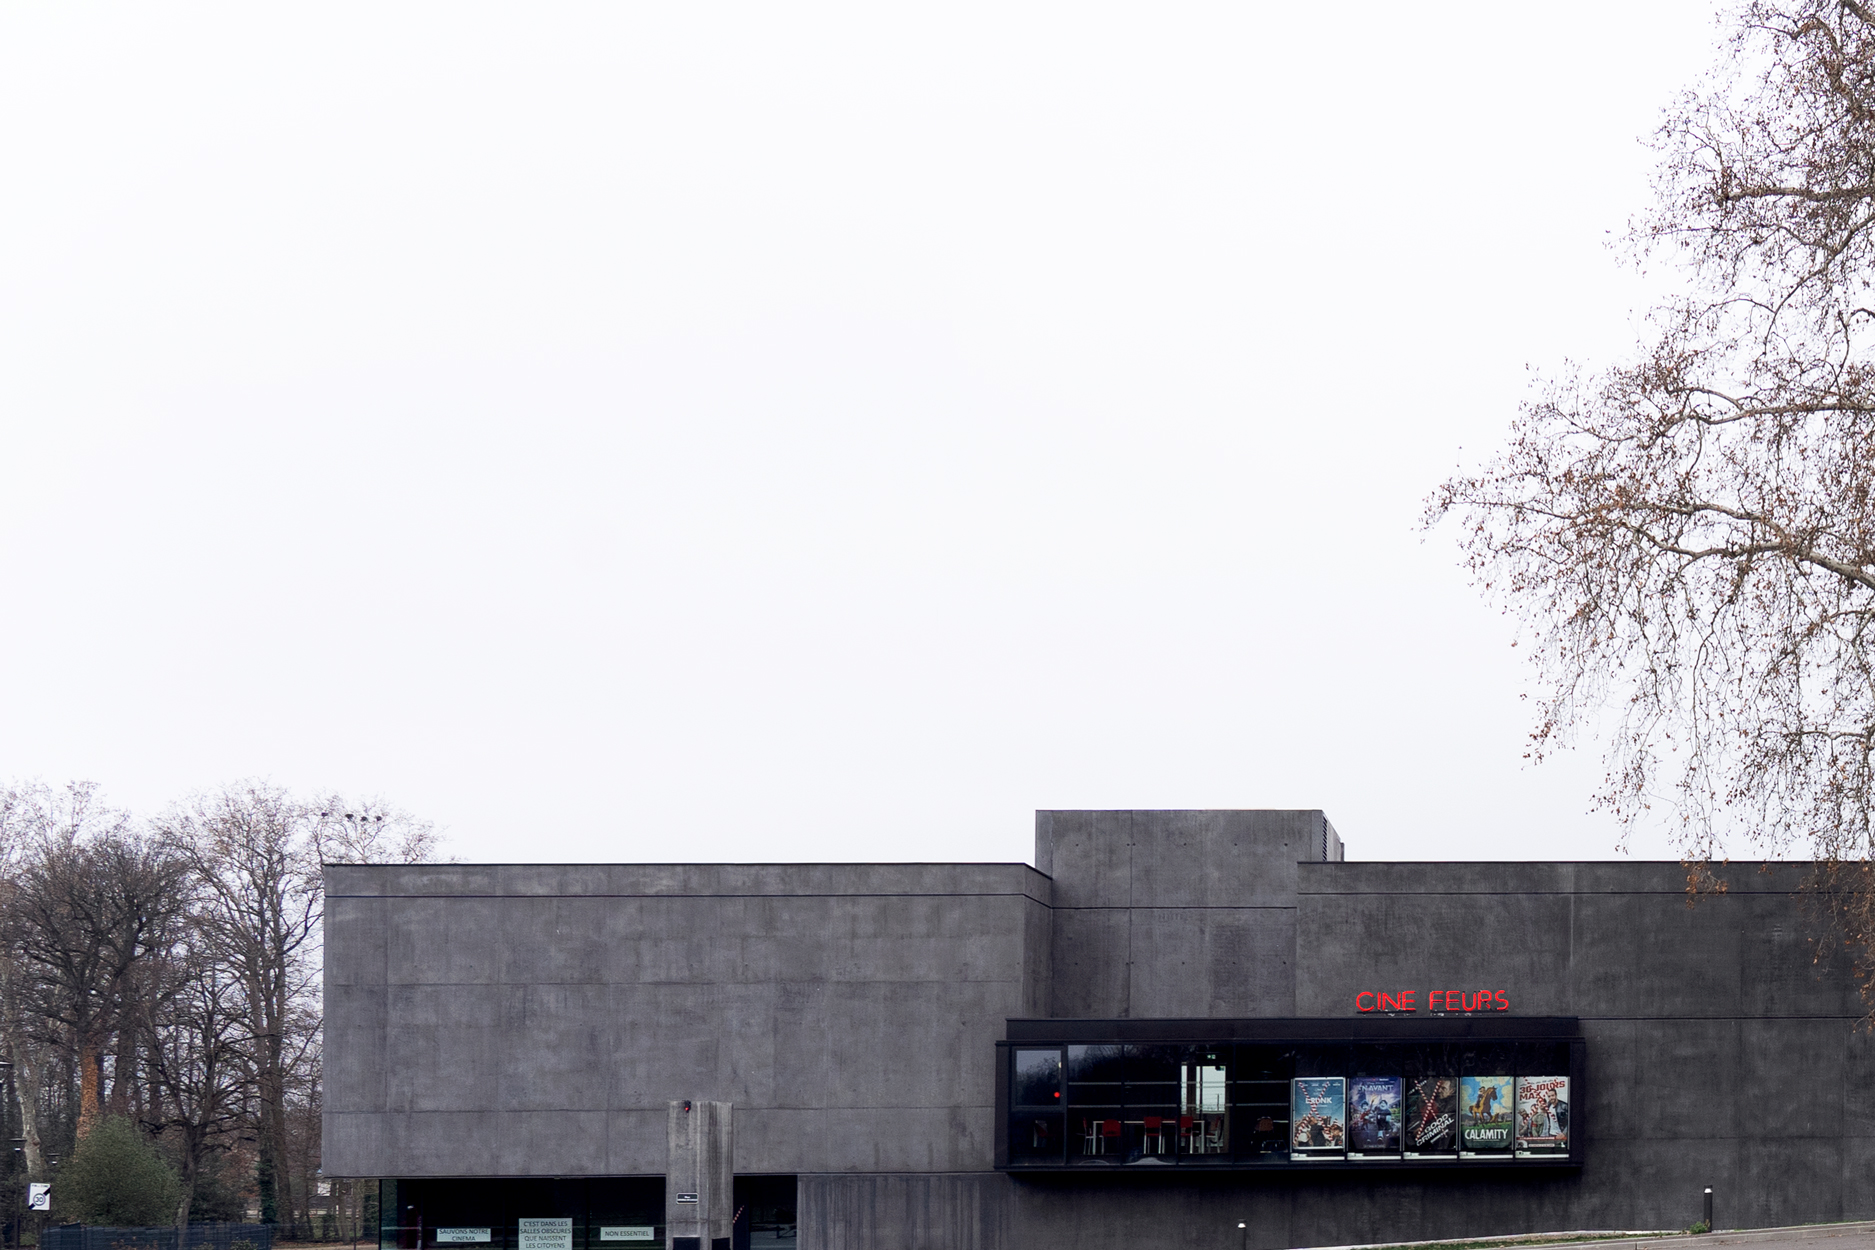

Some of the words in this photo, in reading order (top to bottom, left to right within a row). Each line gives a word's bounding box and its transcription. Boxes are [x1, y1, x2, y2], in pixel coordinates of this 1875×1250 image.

[1356, 990, 1416, 1012] CINE
[1429, 990, 1509, 1012] FEURS
[1368, 1084, 1394, 1092] AVANT
[1416, 1118, 1455, 1147] CRIMINAL
[1465, 1129, 1509, 1140] CALAMITY
